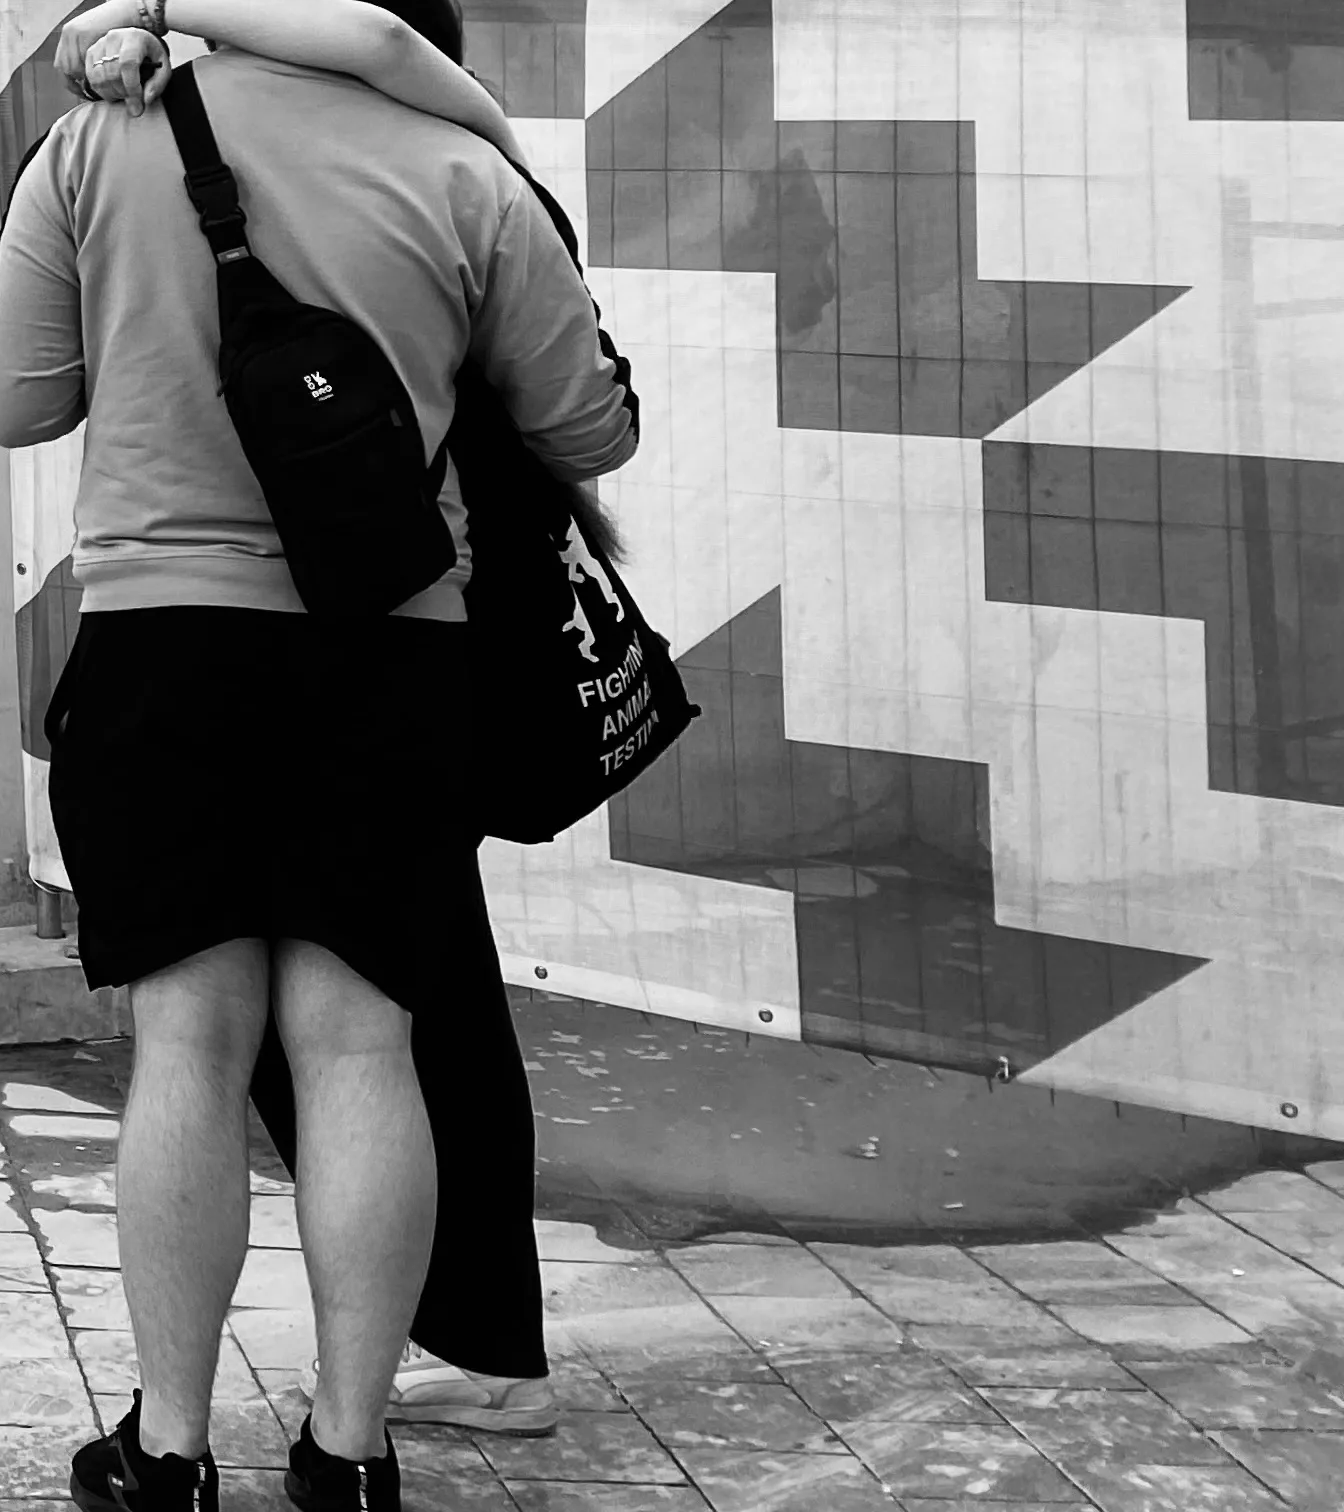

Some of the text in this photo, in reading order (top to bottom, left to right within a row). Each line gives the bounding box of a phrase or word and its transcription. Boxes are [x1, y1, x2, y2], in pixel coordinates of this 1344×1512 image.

[577, 629, 643, 707] FIGHTIN
[603, 673, 651, 740] ANIMA
[600, 709, 659, 775] TESTIN
